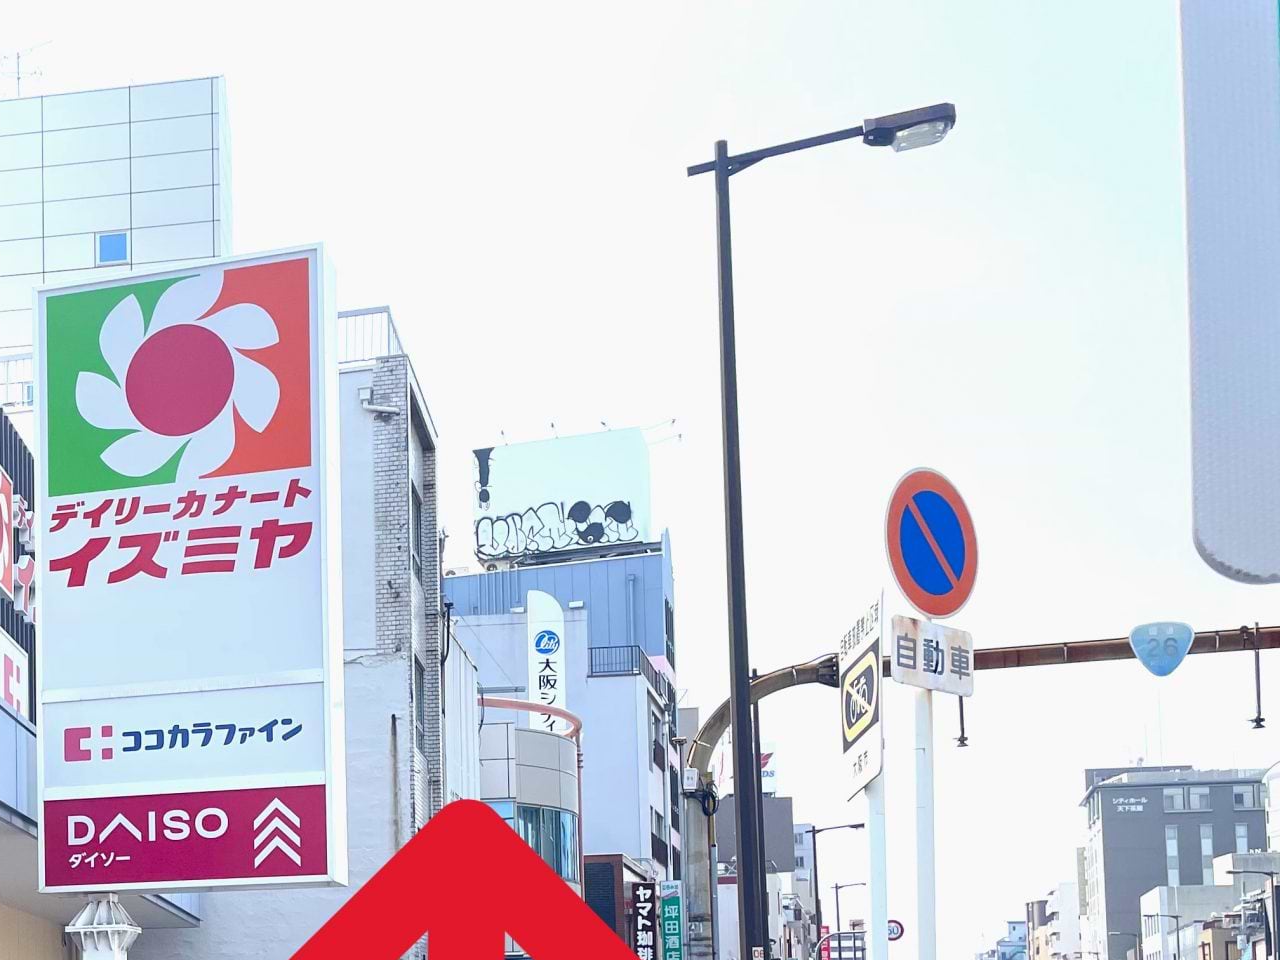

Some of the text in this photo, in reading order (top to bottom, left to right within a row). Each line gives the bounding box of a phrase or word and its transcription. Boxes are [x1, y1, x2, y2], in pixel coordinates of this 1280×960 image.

[49, 478, 312, 533] デイリーカナート
[49, 518, 313, 588] イズミヤ
[896, 633, 970, 680] 自動車
[1147, 637, 1178, 657] 26
[122, 718, 302, 752] ココカラファイン
[67, 808, 228, 846] DAISO
[68, 852, 130, 869] ダイソー
